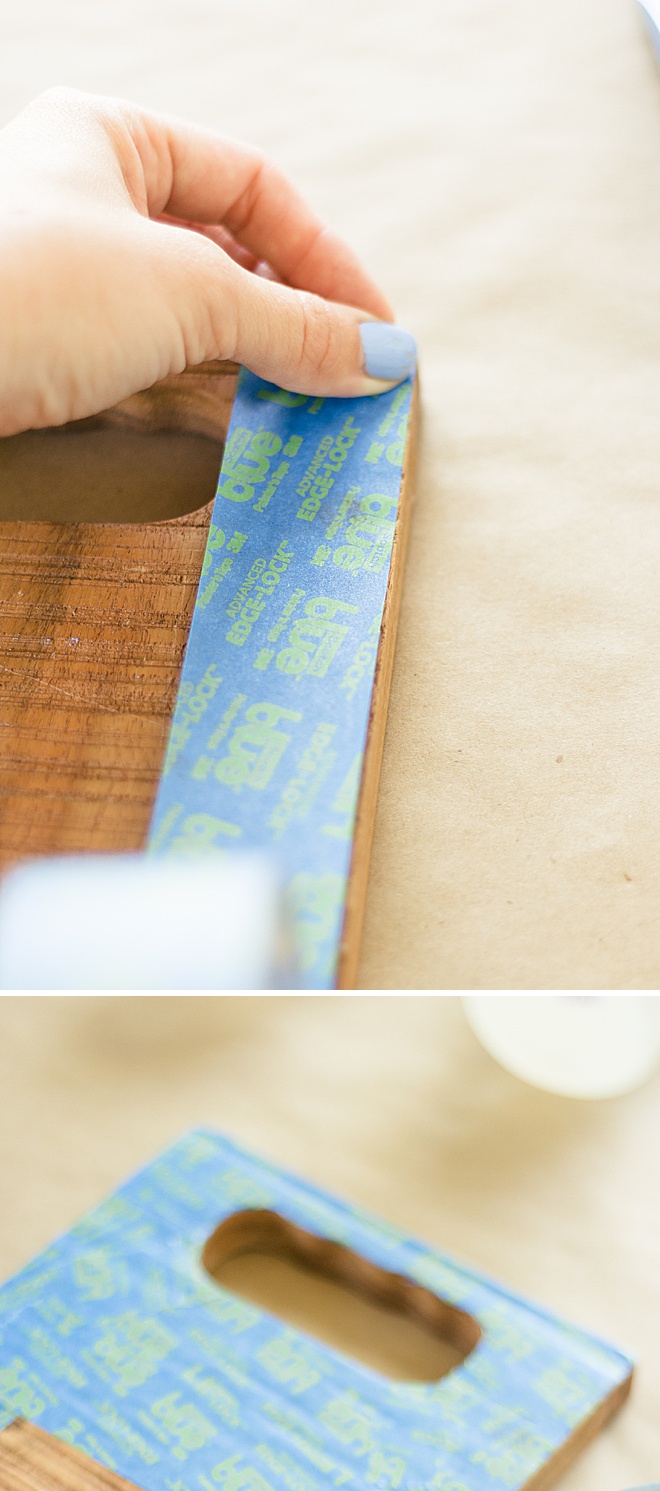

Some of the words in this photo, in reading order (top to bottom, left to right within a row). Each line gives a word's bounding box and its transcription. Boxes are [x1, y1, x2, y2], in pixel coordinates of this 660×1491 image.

[217, 431, 283, 502] blue
[296, 435, 334, 497] ADVANCED
[333, 493, 398, 571] blue
[225, 557, 267, 619] ADVANCED
[276, 597, 361, 675] blue
